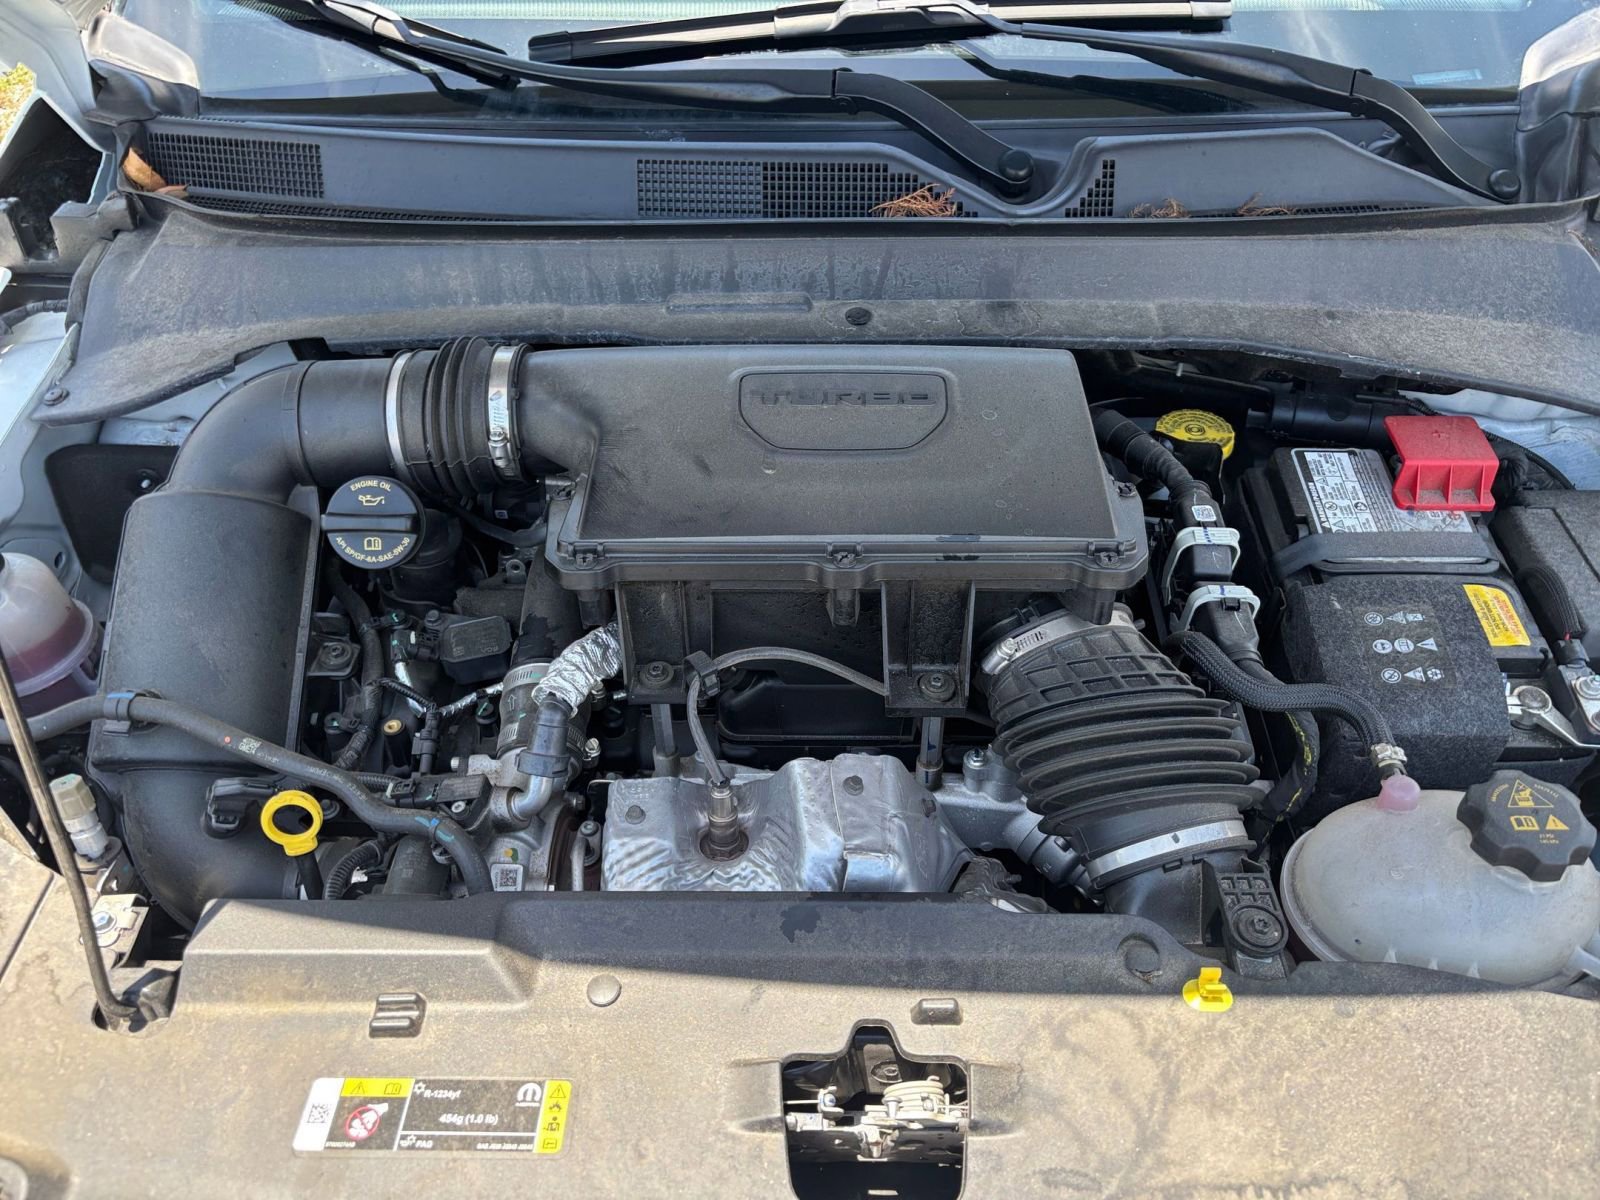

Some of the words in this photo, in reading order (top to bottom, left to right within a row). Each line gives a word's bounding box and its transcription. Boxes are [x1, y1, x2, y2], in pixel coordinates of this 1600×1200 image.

[350, 480, 377, 492] ENGINE
[379, 481, 392, 492] OIL
[336, 536, 345, 549] API
[424, 1089, 462, 1100] R-1234yf
[438, 1114, 464, 1125] 454g
[465, 1113, 484, 1125] (1.0
[485, 1114, 499, 1125] lb)
